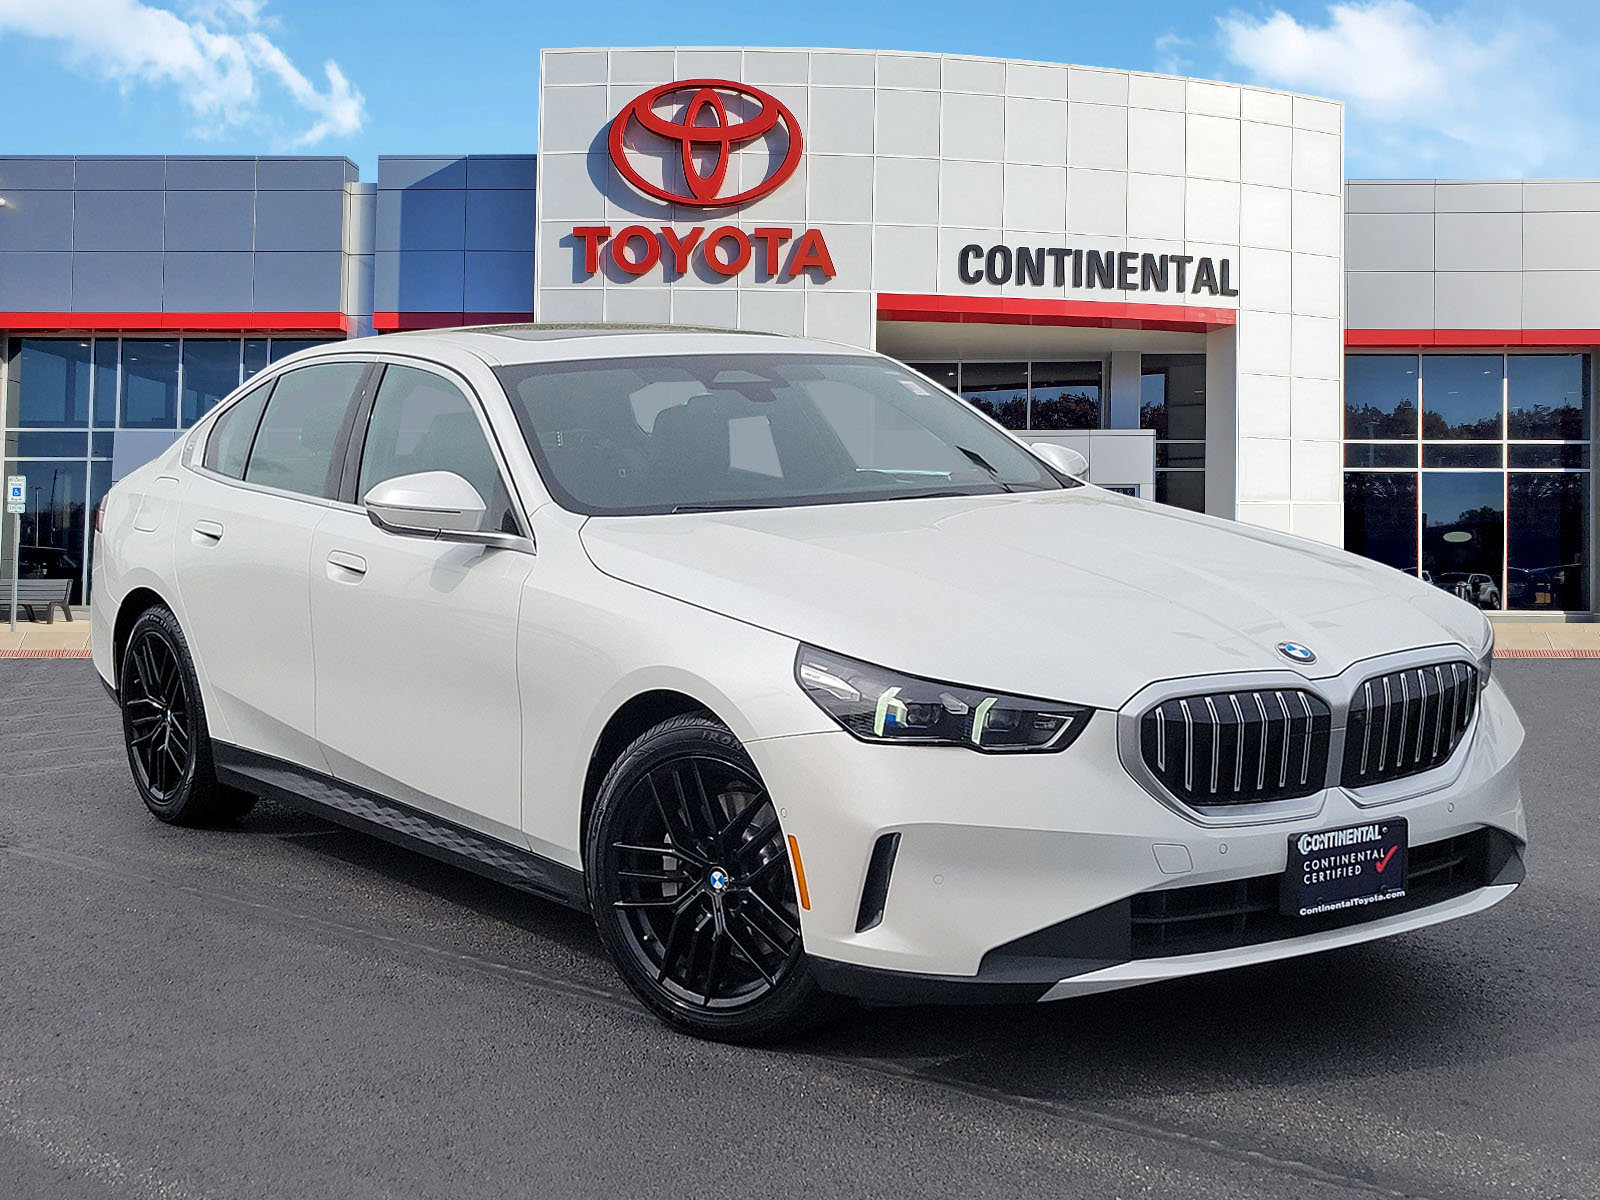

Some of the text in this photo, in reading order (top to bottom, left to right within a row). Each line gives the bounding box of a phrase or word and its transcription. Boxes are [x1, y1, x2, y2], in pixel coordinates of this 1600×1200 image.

[573, 225, 837, 276] TOYOTA
[957, 244, 1239, 297] CONTINENTAL
[1298, 824, 1382, 855] CONTINENTAL
[1303, 847, 1385, 872] CONTINENTAL
[1303, 864, 1362, 885] CERTIFIED
[1299, 890, 1406, 916] ContinentalToyota.com
